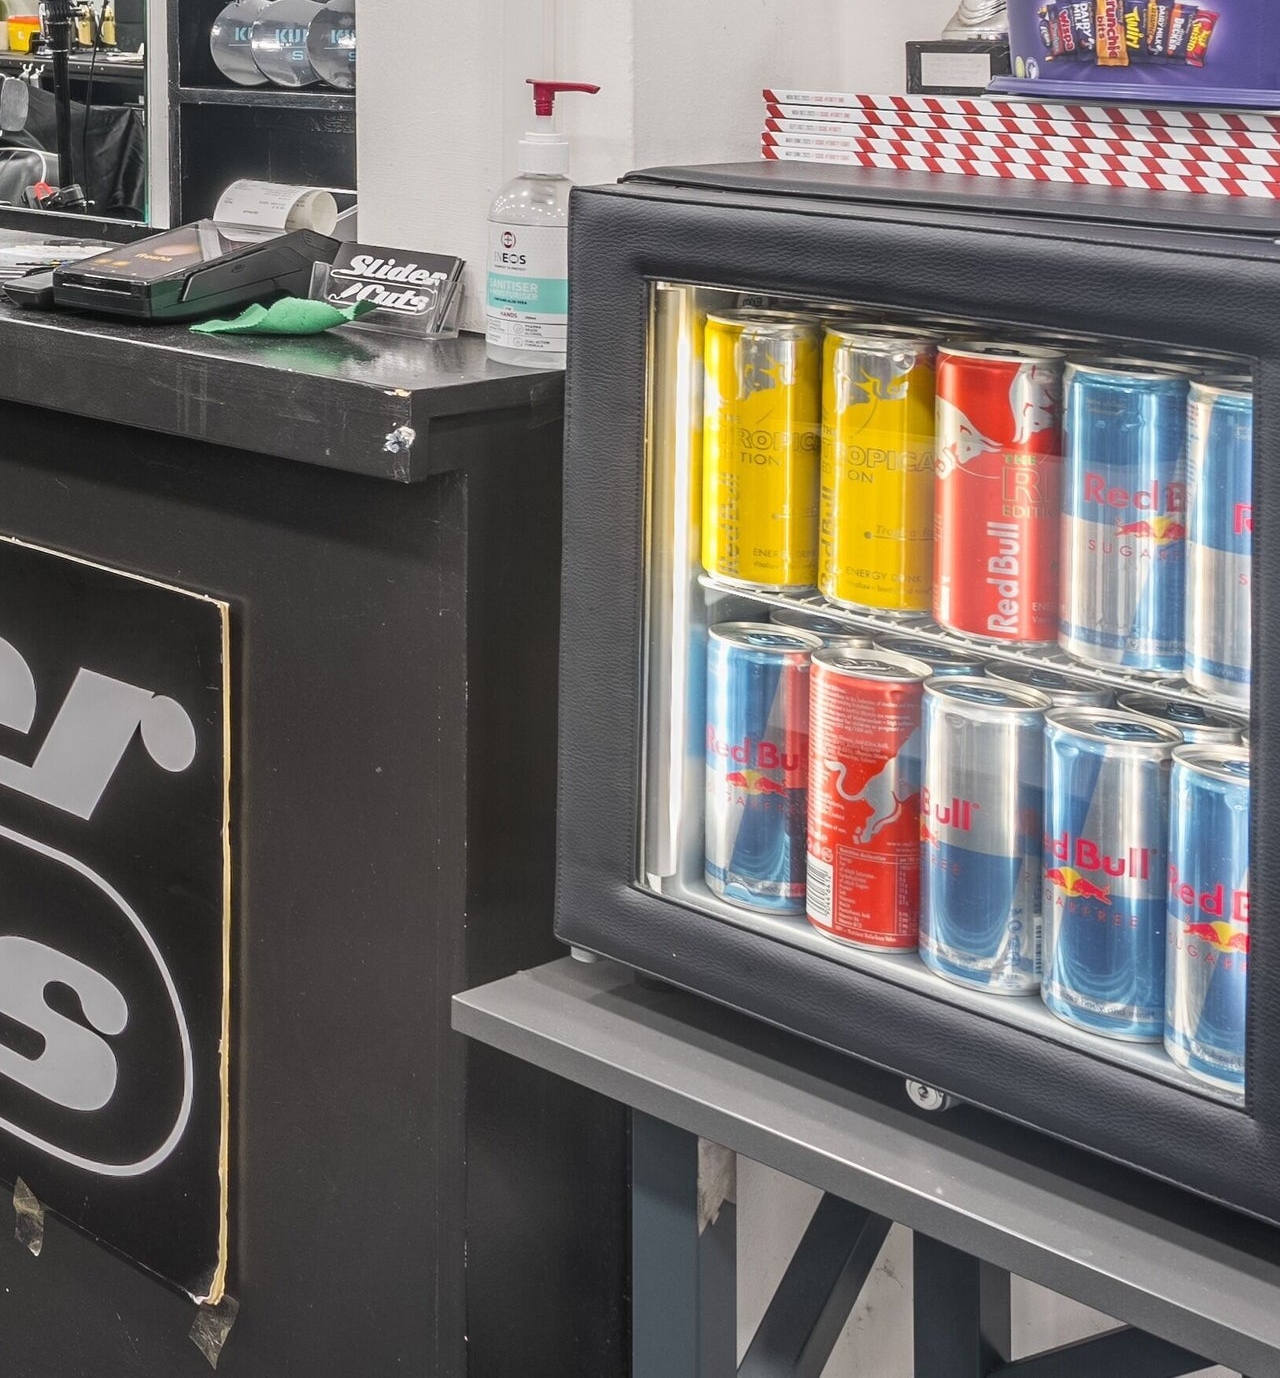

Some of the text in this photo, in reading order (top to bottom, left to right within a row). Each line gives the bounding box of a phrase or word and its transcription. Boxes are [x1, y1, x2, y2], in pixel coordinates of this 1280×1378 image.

[1072, 4, 1082, 30] MILK
[1078, 2, 1092, 39] DAIRY
[347, 254, 448, 286] Slider
[489, 278, 538, 294] SANITISER
[356, 284, 430, 314] Cuts
[1082, 472, 1158, 512] Red
[986, 521, 1020, 634] Red Bull
[756, 742, 801, 772] Bu
[1076, 837, 1150, 880] Bull
[1046, 888, 1139, 929] GARFREE
